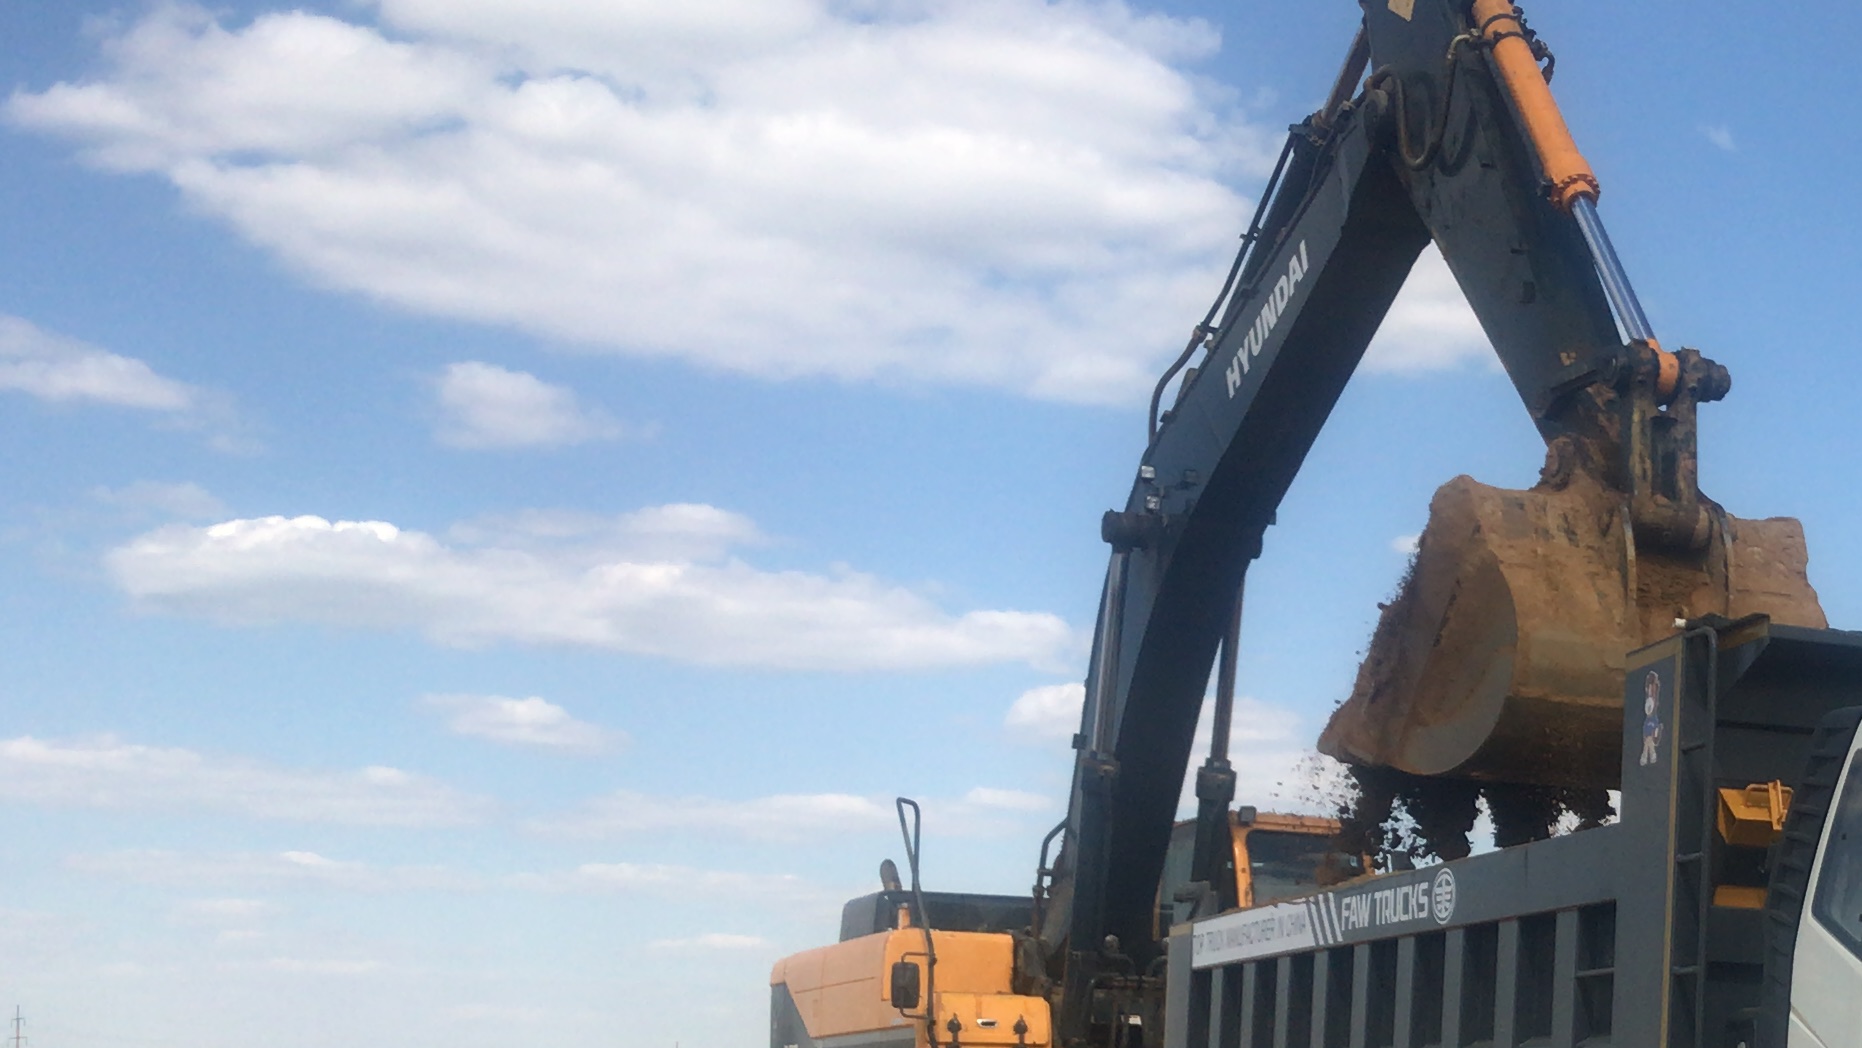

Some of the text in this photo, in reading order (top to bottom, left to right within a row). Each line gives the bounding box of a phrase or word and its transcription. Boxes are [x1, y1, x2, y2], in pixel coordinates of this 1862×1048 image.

[1226, 240, 1308, 399] HYUNDAI
[1341, 893, 1371, 931] FAW
[1374, 882, 1429, 925] TRUCKS
